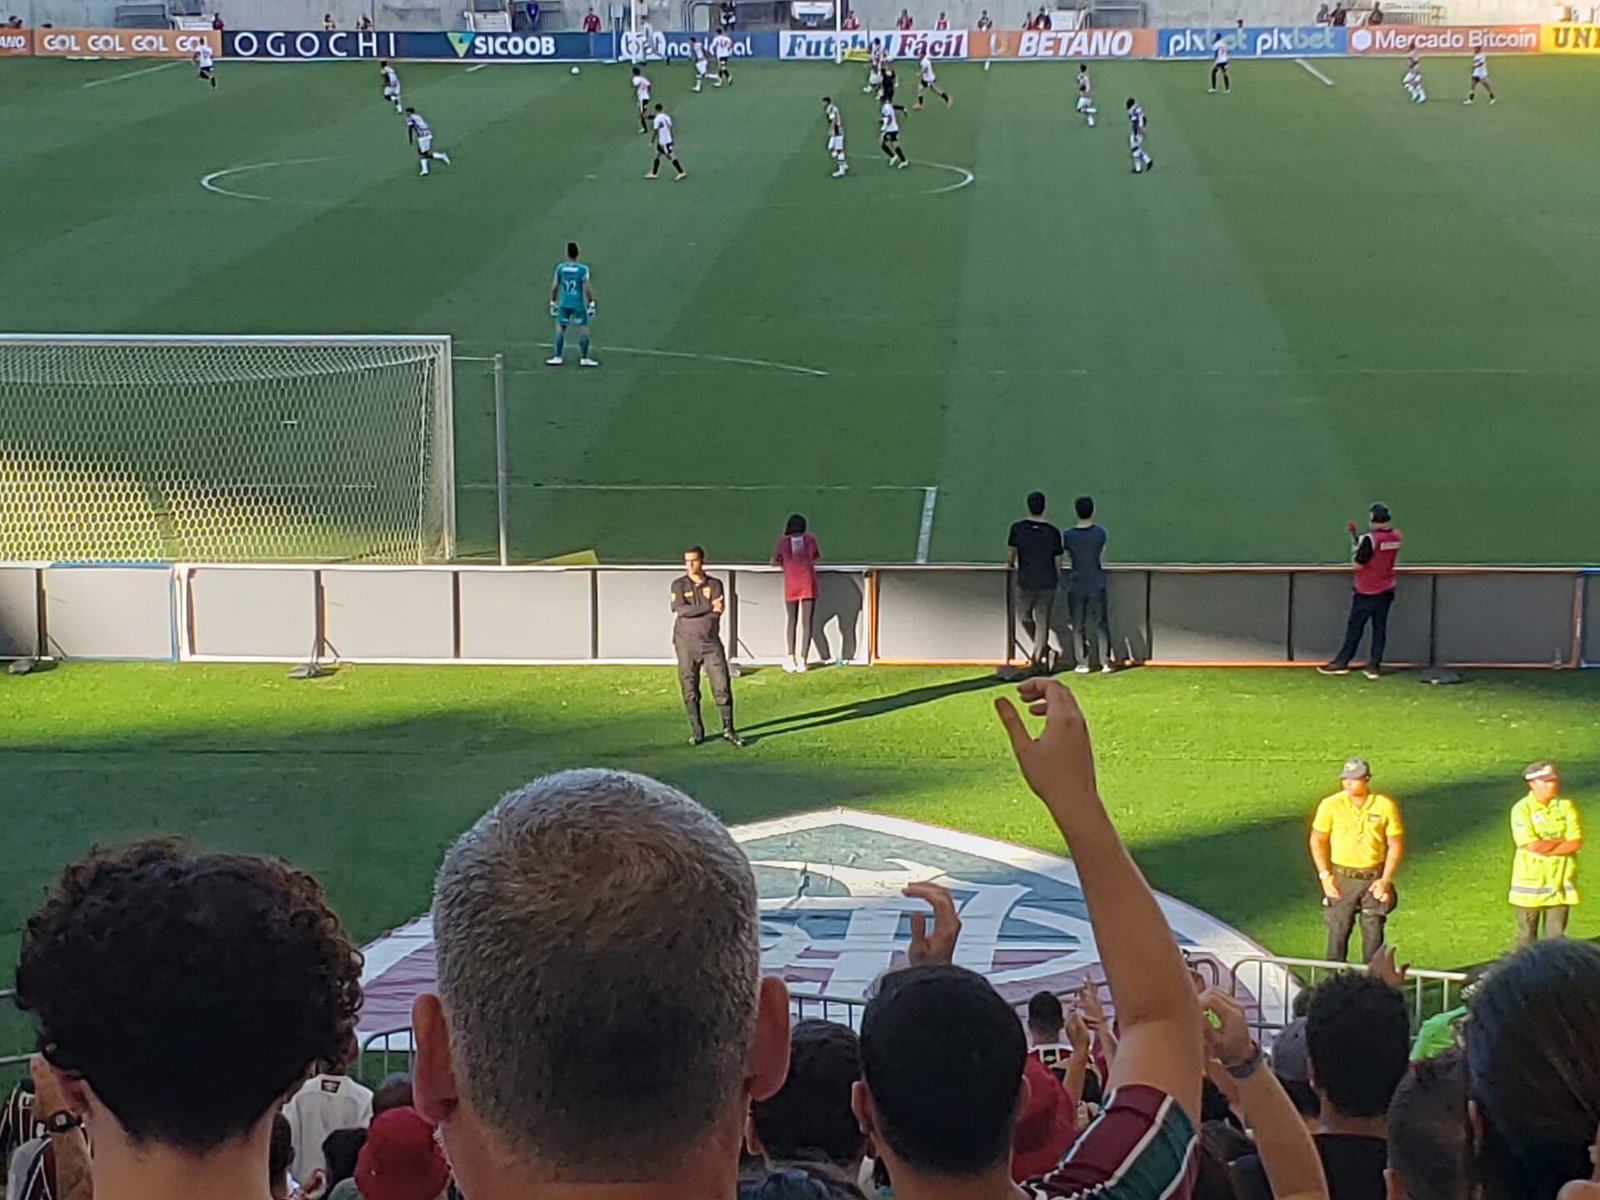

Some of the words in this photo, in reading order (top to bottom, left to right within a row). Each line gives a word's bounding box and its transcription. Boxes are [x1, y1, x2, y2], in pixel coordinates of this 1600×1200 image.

[43, 35, 80, 51] GOL
[87, 35, 124, 51] GOL
[131, 35, 168, 51] GOL
[233, 32, 396, 57] OGOCHI
[474, 36, 556, 55] SICOOB
[786, 34, 893, 57] Futebl
[896, 33, 963, 57] Fácil
[1018, 31, 1133, 57] BETANO
[1256, 27, 1336, 55] pixbet
[1375, 29, 1463, 49] Mercado
[1468, 28, 1537, 48] Bitcoin
